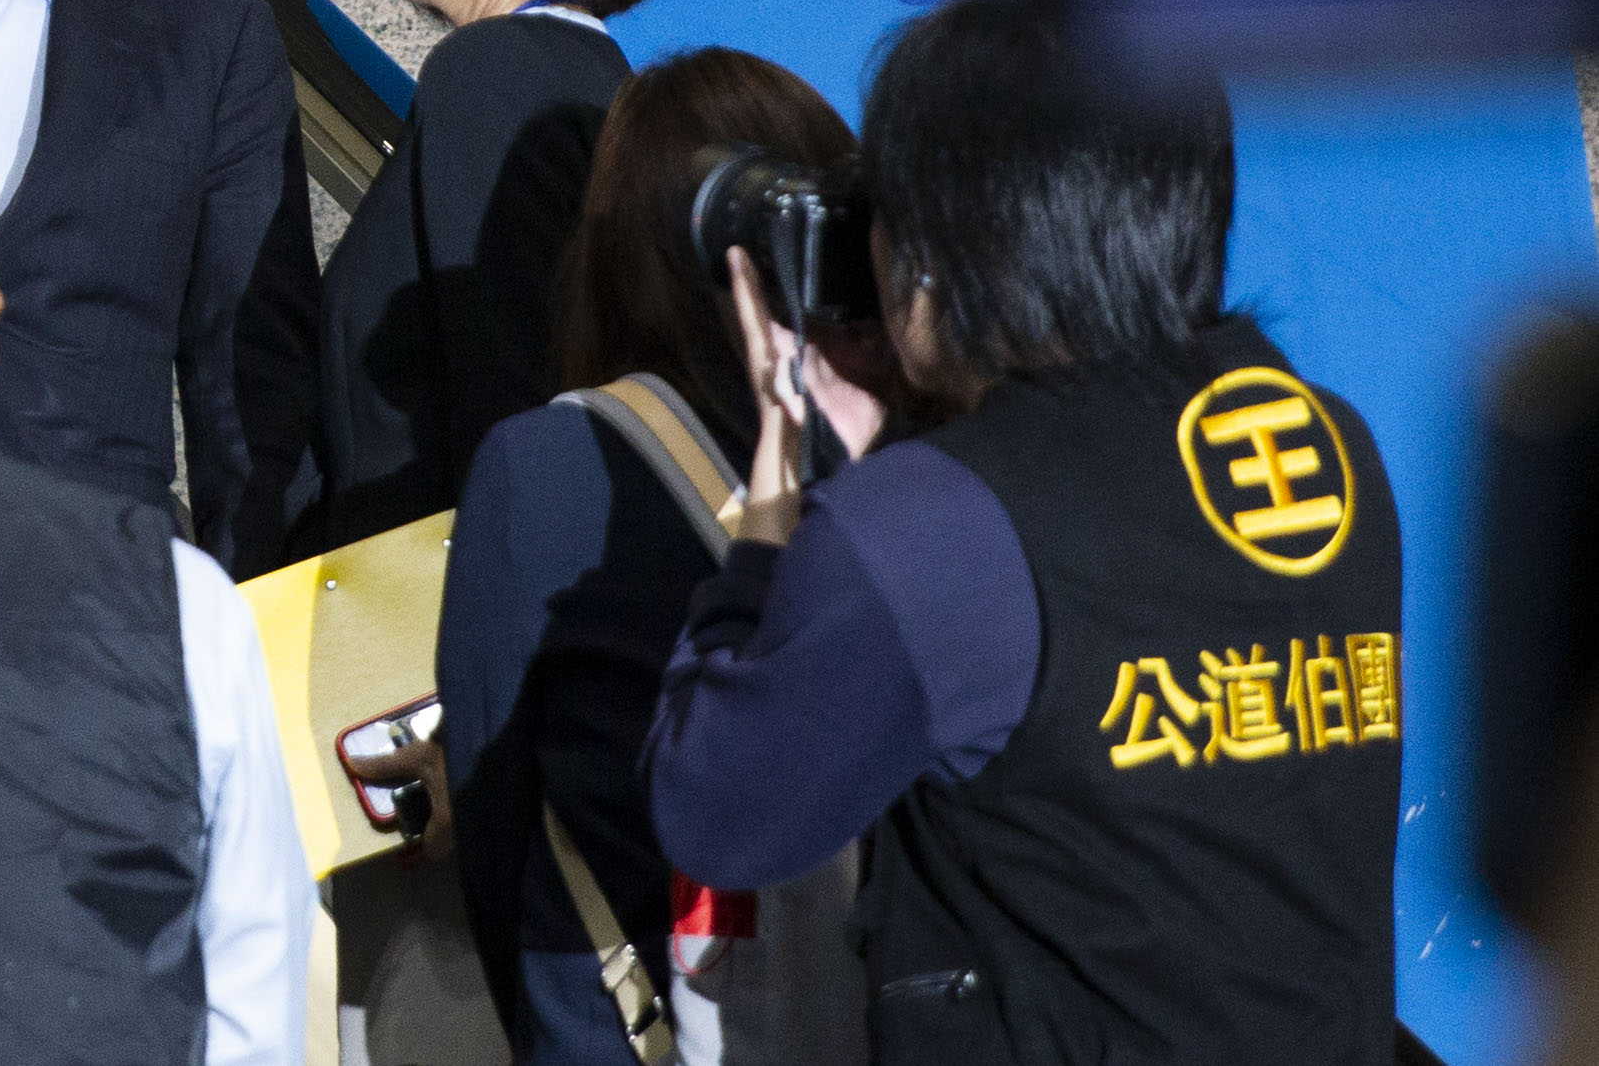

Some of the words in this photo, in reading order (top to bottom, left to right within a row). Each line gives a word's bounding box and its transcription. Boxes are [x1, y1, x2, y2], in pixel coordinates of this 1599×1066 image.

[1201, 395, 1344, 541] 王
[1099, 631, 1399, 770] 公道伯團
